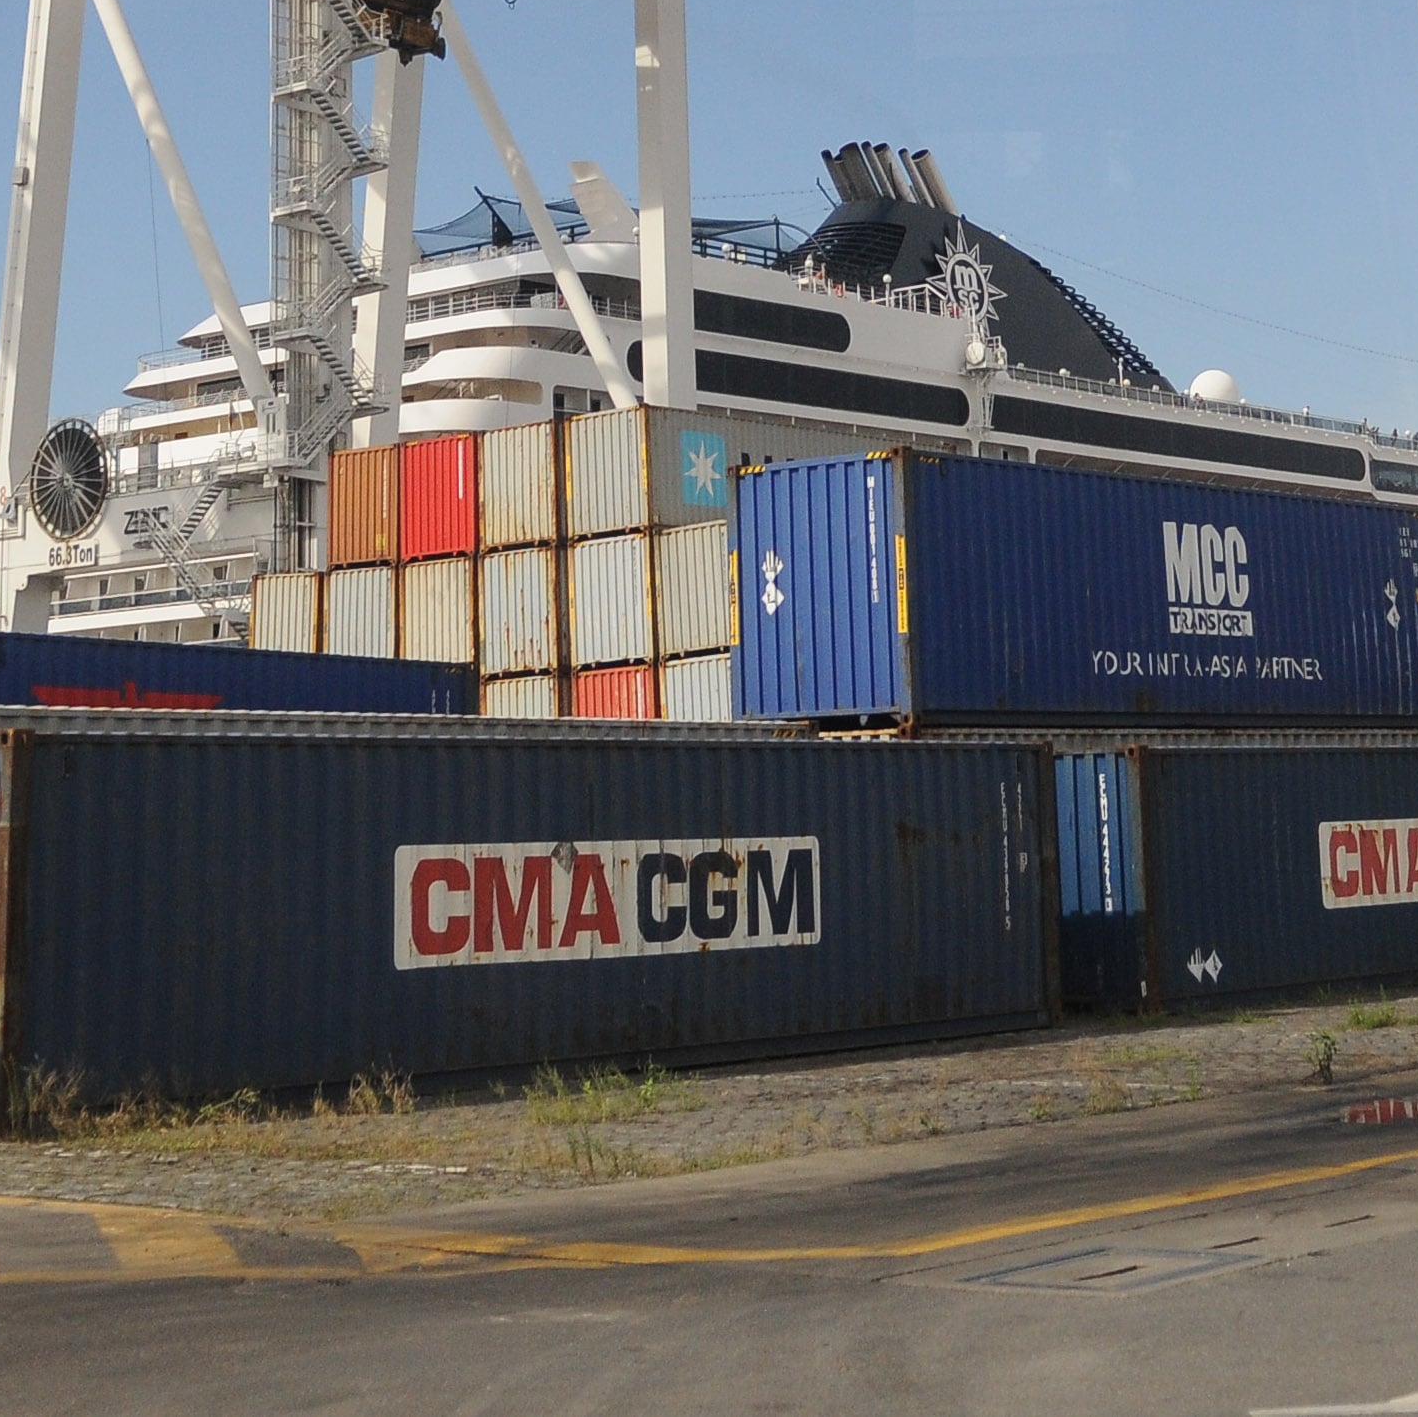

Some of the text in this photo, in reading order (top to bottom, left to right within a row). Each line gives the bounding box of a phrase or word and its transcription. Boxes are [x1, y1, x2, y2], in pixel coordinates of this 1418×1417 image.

[49, 544, 93, 566] 66.3Ton
[1163, 521, 1250, 607] MCC
[1092, 650, 1144, 677] YOUR
[410, 848, 816, 956] CMA CGM
